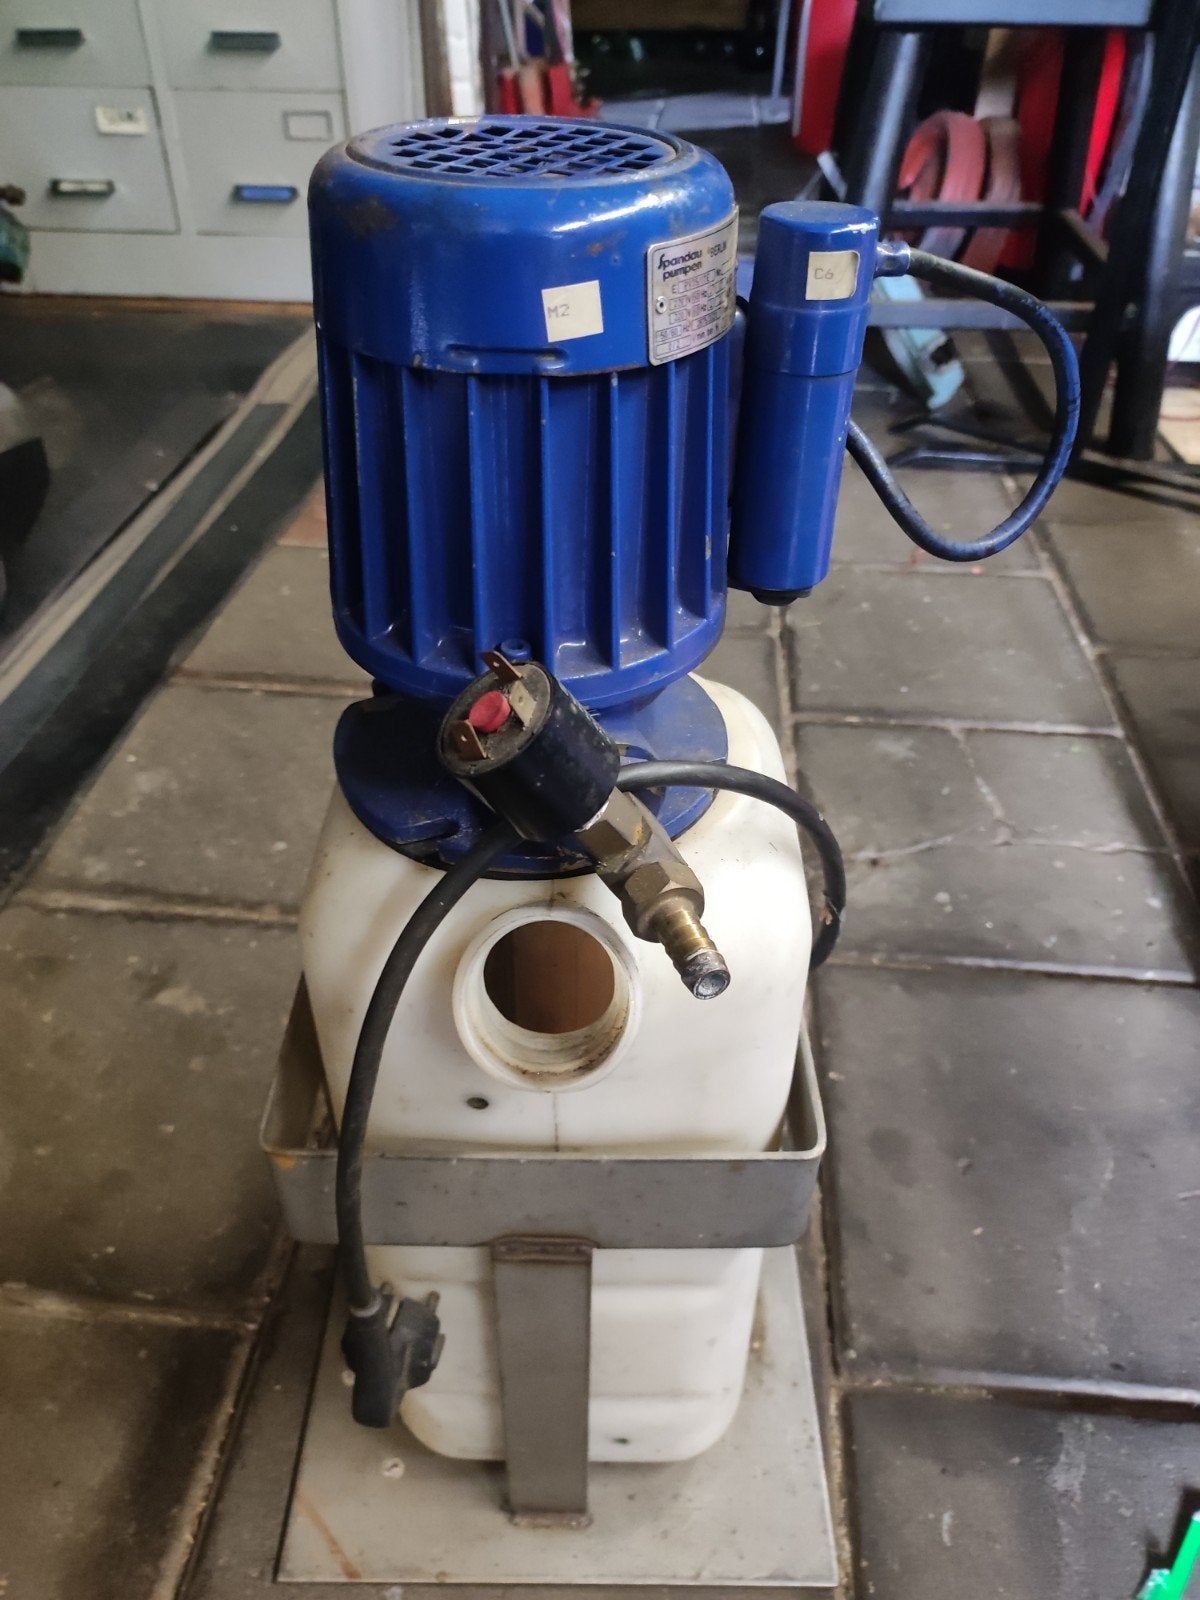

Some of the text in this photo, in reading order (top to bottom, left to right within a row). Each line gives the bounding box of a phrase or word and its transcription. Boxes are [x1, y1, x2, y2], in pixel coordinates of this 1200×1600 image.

[657, 250, 703, 270] Spandau
[662, 261, 702, 282] pumpen
[814, 267, 834, 280] C6
[547, 303, 570, 319] M2
